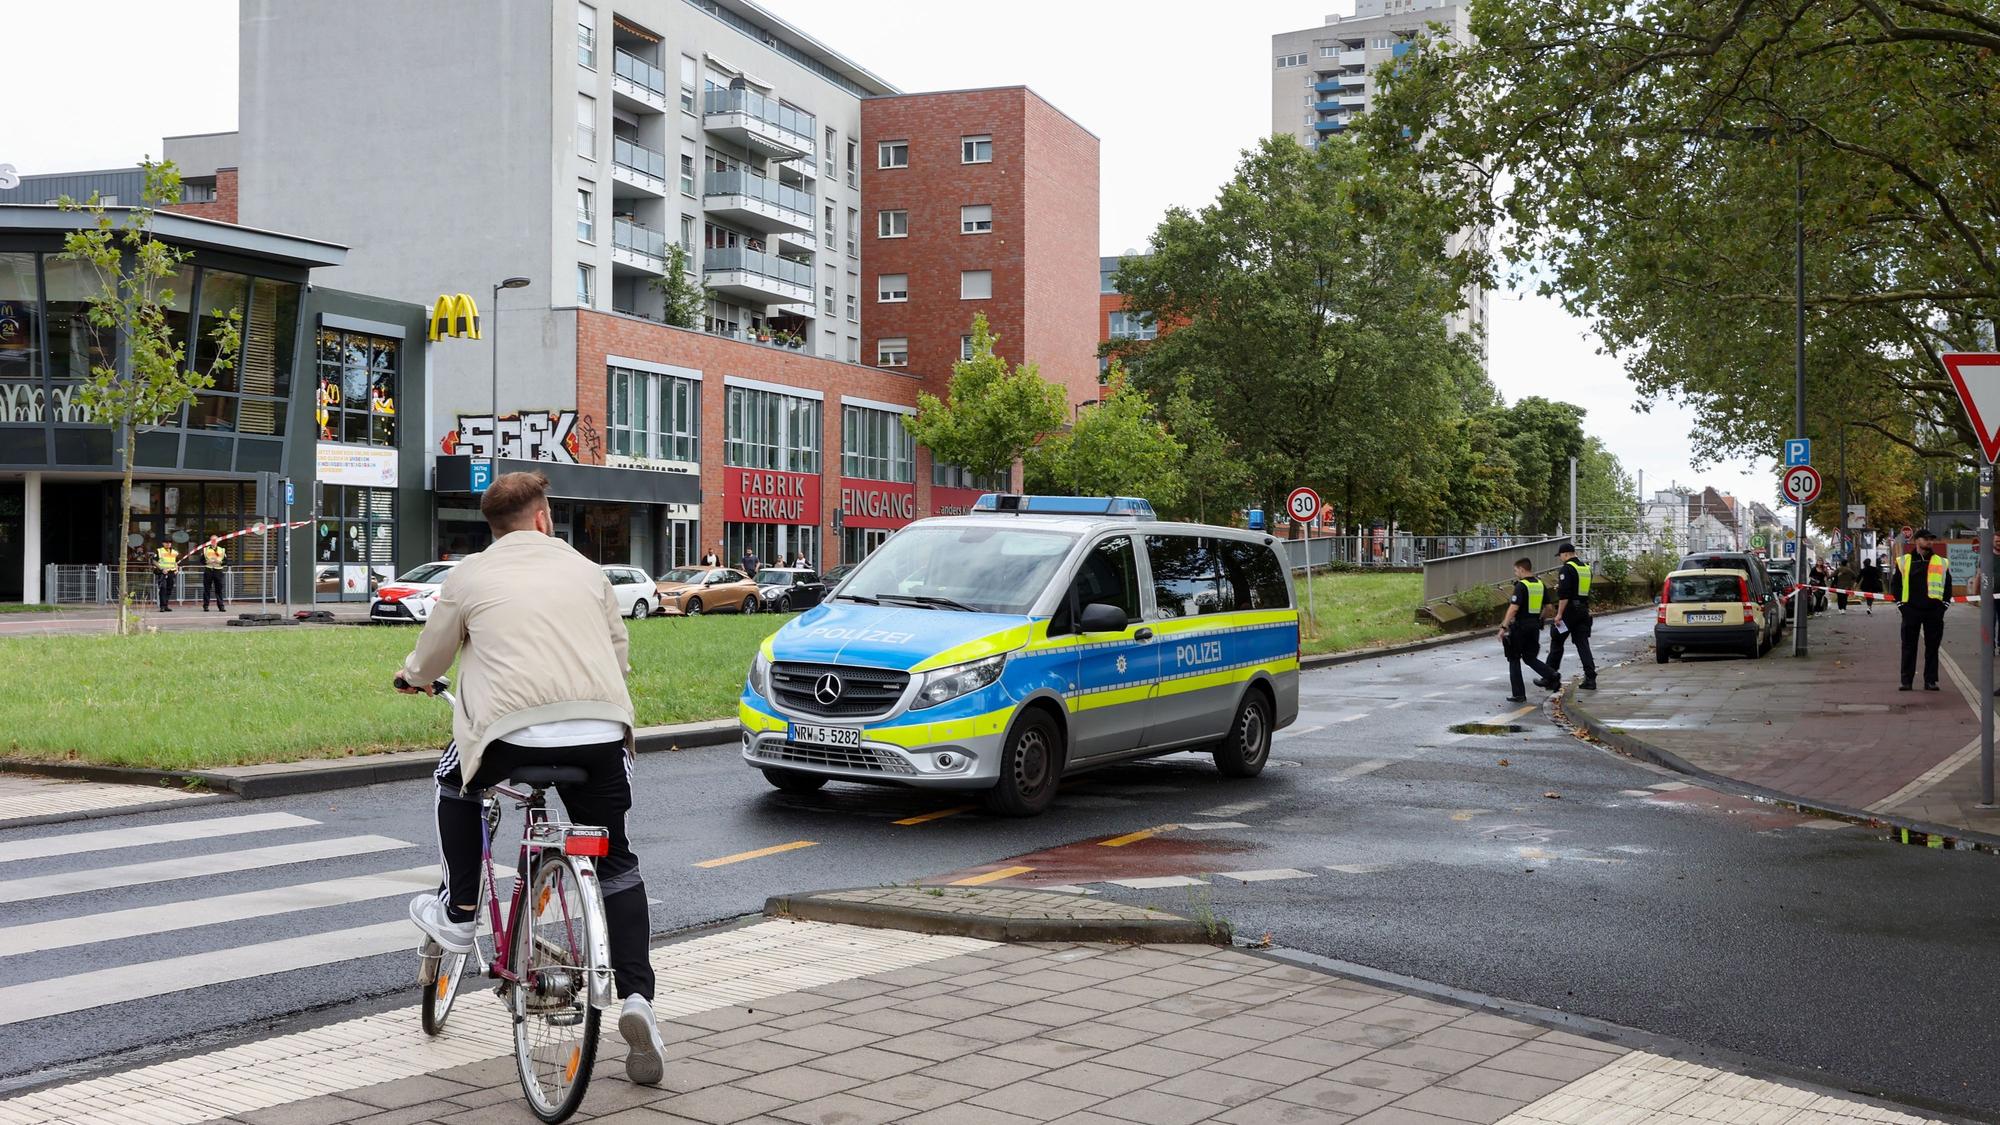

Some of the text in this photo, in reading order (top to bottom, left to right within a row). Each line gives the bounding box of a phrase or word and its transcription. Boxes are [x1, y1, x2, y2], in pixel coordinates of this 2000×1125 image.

[1791, 443, 1805, 463] P
[474, 472, 487, 488] P
[741, 472, 805, 497] FABRIK
[1791, 476, 1812, 492] 30
[741, 496, 805, 520] VERKAUF
[841, 488, 913, 519] EINGANG
[1294, 496, 1313, 513] 30
[806, 627, 915, 644] POLIZEI
[1176, 640, 1222, 668] POLIZEI
[794, 725, 858, 745] NRW 5-5282
